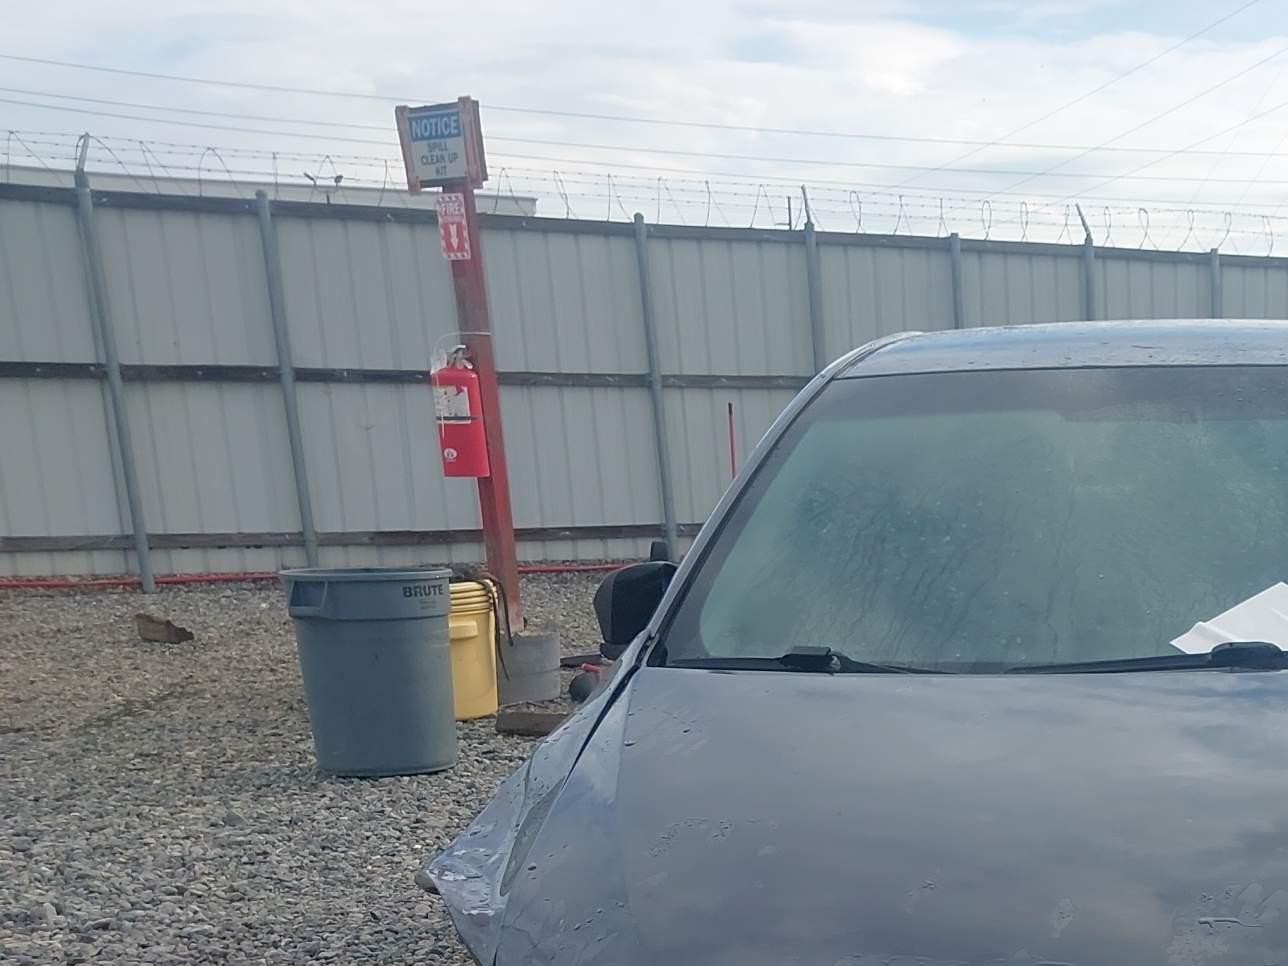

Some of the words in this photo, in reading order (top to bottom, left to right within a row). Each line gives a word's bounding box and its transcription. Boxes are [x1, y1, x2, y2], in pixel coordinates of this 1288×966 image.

[411, 115, 459, 138] NOTICE
[421, 154, 446, 166] CLEAN
[448, 152, 459, 163] UP
[402, 584, 444, 597] BRUTE
